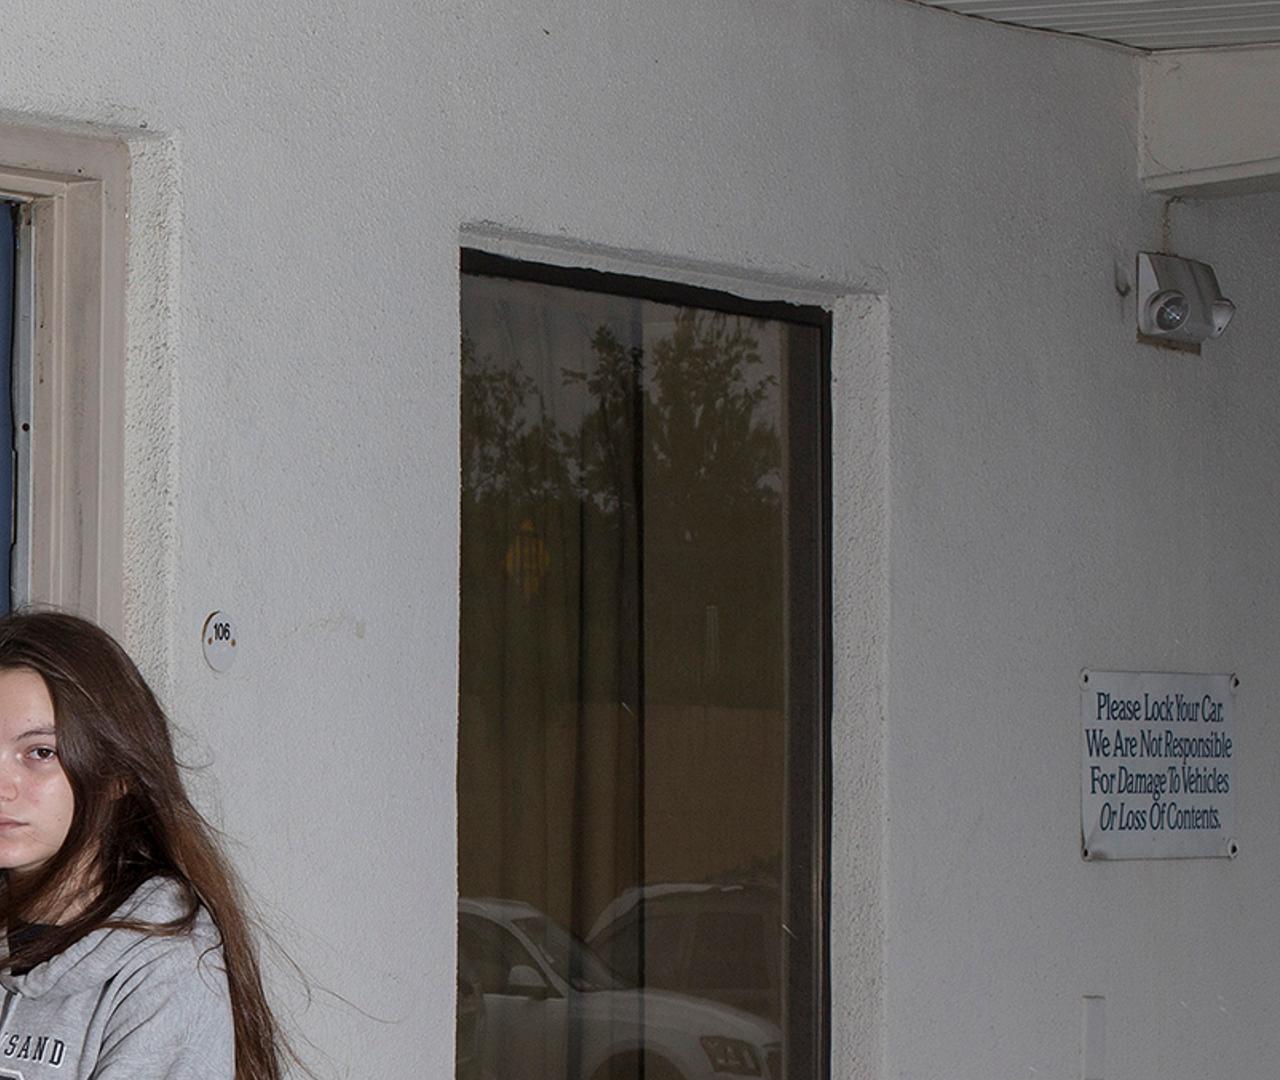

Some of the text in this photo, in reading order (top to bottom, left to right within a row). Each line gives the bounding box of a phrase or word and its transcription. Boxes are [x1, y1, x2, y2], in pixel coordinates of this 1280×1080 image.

[213, 622, 231, 641] 106
[1096, 691, 1224, 723] Please Lock Your Car.
[1085, 728, 1233, 765] We Are Not Responsible
[1090, 766, 1230, 801] For Damage To Vehicles
[1099, 802, 1222, 831] Or Loss Of Contents.
